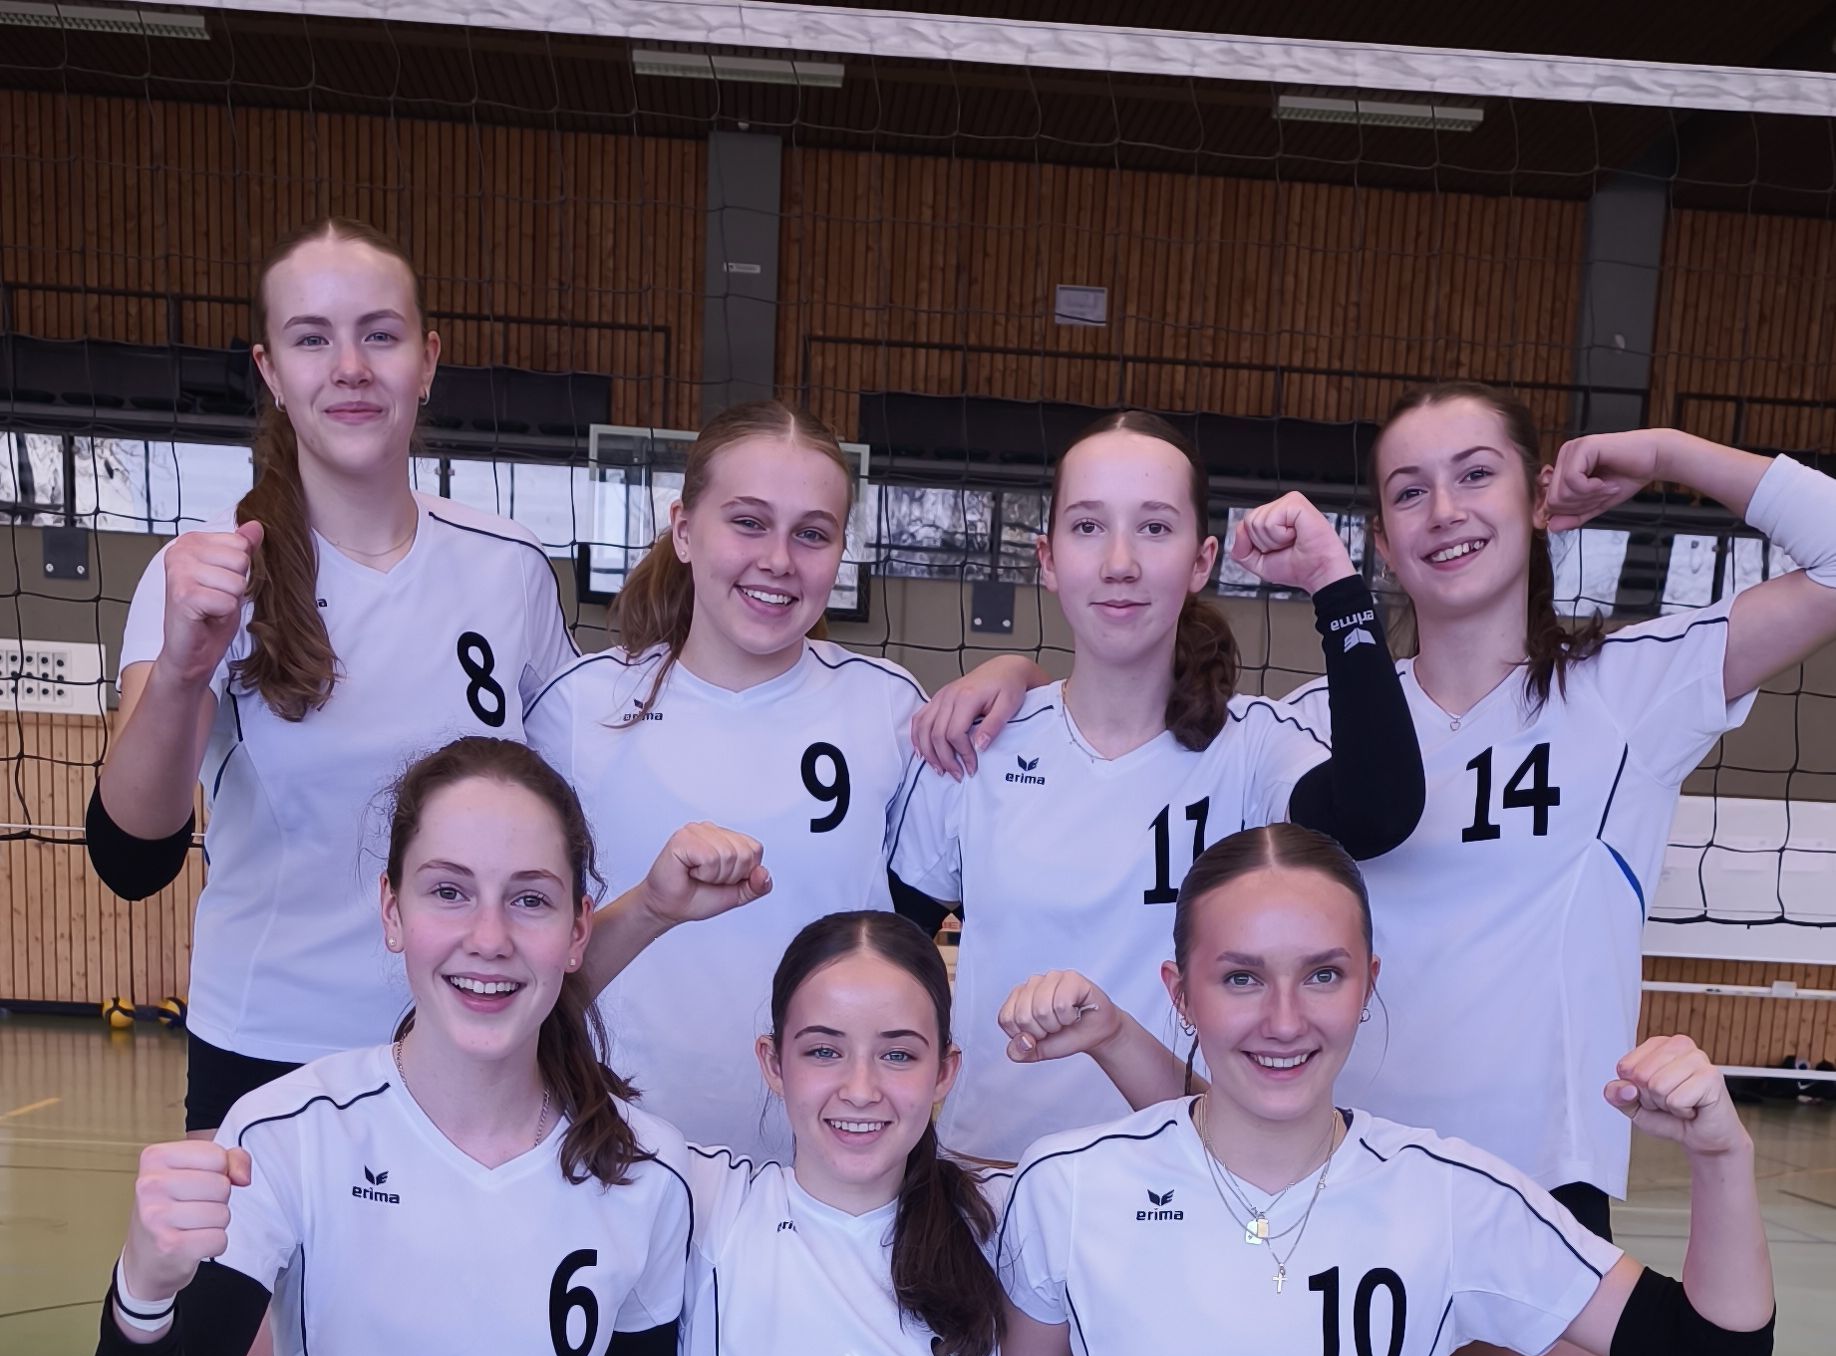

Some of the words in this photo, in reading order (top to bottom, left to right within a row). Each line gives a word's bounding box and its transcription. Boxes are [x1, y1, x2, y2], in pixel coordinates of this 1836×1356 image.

[1330, 609, 1374, 631] erima
[457, 632, 505, 728] 8
[623, 709, 664, 721] erma
[801, 742, 850, 834] 9
[1005, 772, 1046, 786] erima
[1462, 743, 1561, 843] 14
[352, 1186, 400, 1204] erima
[1136, 1208, 1184, 1221] erima
